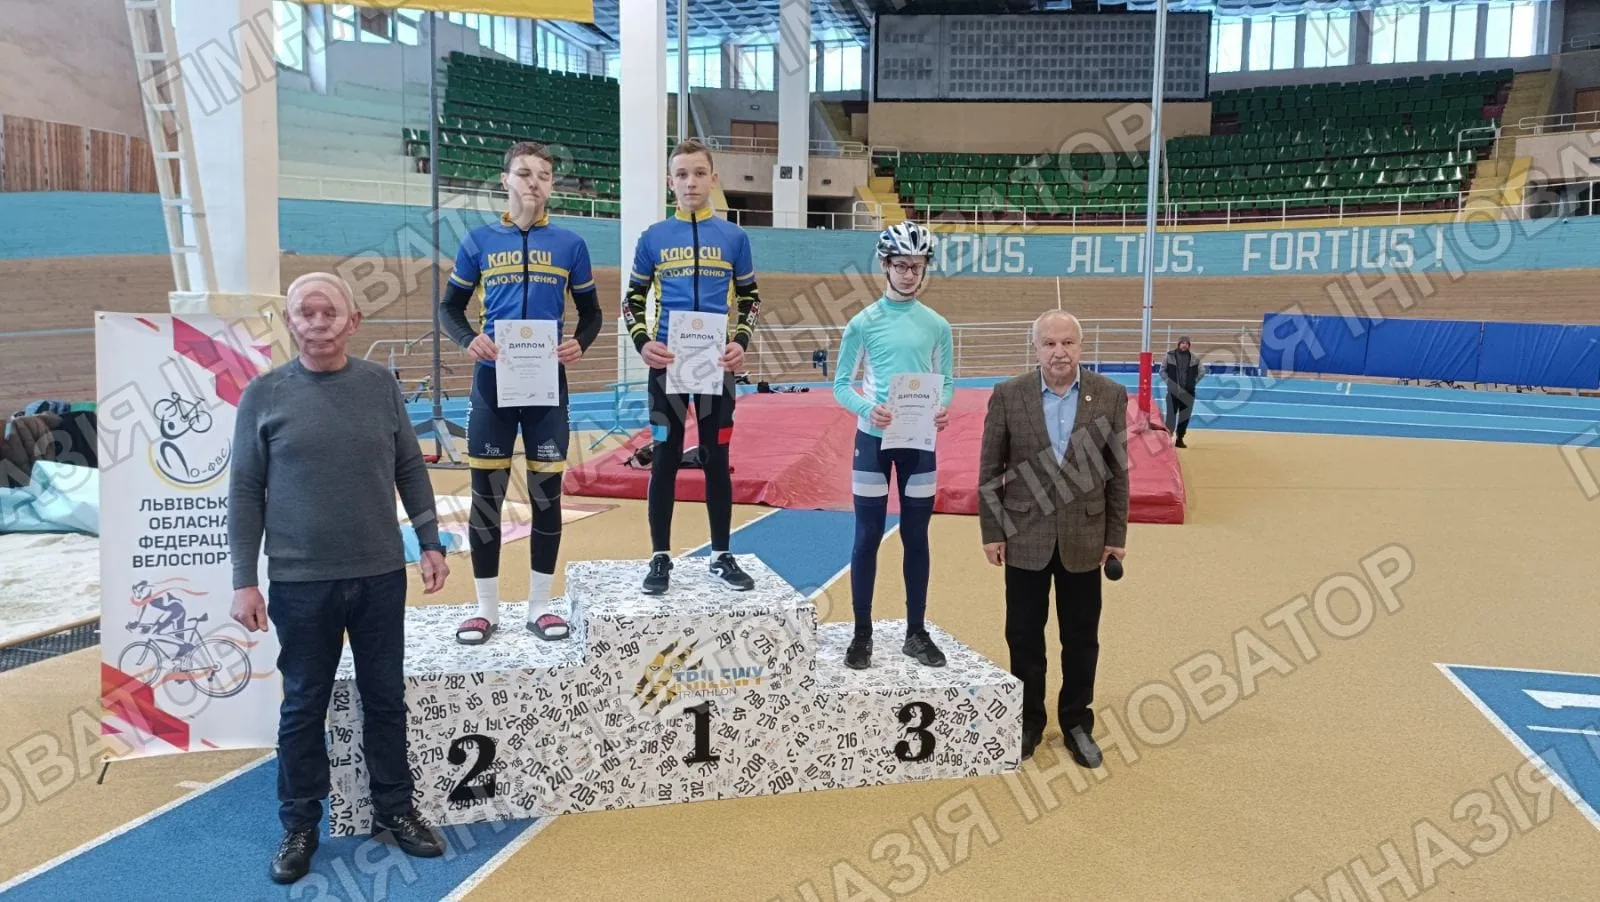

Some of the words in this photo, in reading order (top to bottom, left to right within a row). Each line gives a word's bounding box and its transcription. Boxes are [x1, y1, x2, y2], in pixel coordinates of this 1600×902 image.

[679, 332, 715, 340] ДИПЛОМ
[508, 342, 545, 350] ДИПЛОМ
[138, 496, 228, 512] ЛЬВІВСЬК
[138, 533, 229, 550] ФЕДЕРАЦІ
[132, 552, 231, 568] ВЕЛОСПОР
[715, 630, 736, 649] 291
[753, 634, 775, 656] 275
[617, 640, 640, 660] 299
[783, 640, 805, 661] 275
[444, 675, 466, 690] 282
[334, 690, 350, 713] 324
[491, 689, 508, 706] 89
[743, 689, 766, 710] 299
[944, 686, 959, 702] 20
[424, 704, 447, 720] 295
[539, 704, 562, 722] 240
[565, 701, 589, 722] 240
[732, 706, 747, 721] 45
[950, 711, 968, 726] 281
[956, 698, 979, 722] 229
[987, 698, 1008, 720] 170
[515, 713, 540, 736] 288
[756, 712, 778, 730] 276
[683, 700, 720, 763] 1
[717, 722, 740, 741] 284
[836, 731, 858, 750] 216
[894, 701, 936, 762] 3
[962, 729, 980, 745] 219
[420, 746, 444, 765] 279
[640, 740, 658, 754] 318
[983, 736, 1006, 761] 229
[447, 734, 496, 802] 2
[600, 756, 621, 773] 105
[656, 755, 679, 777] 298
[741, 753, 767, 780] 208
[841, 756, 854, 771] 27
[433, 775, 457, 794] 291
[546, 766, 574, 791] 240
[733, 776, 756, 796] 237
[768, 771, 794, 795] 209
[569, 782, 598, 806] 205
[658, 783, 672, 801] 281
